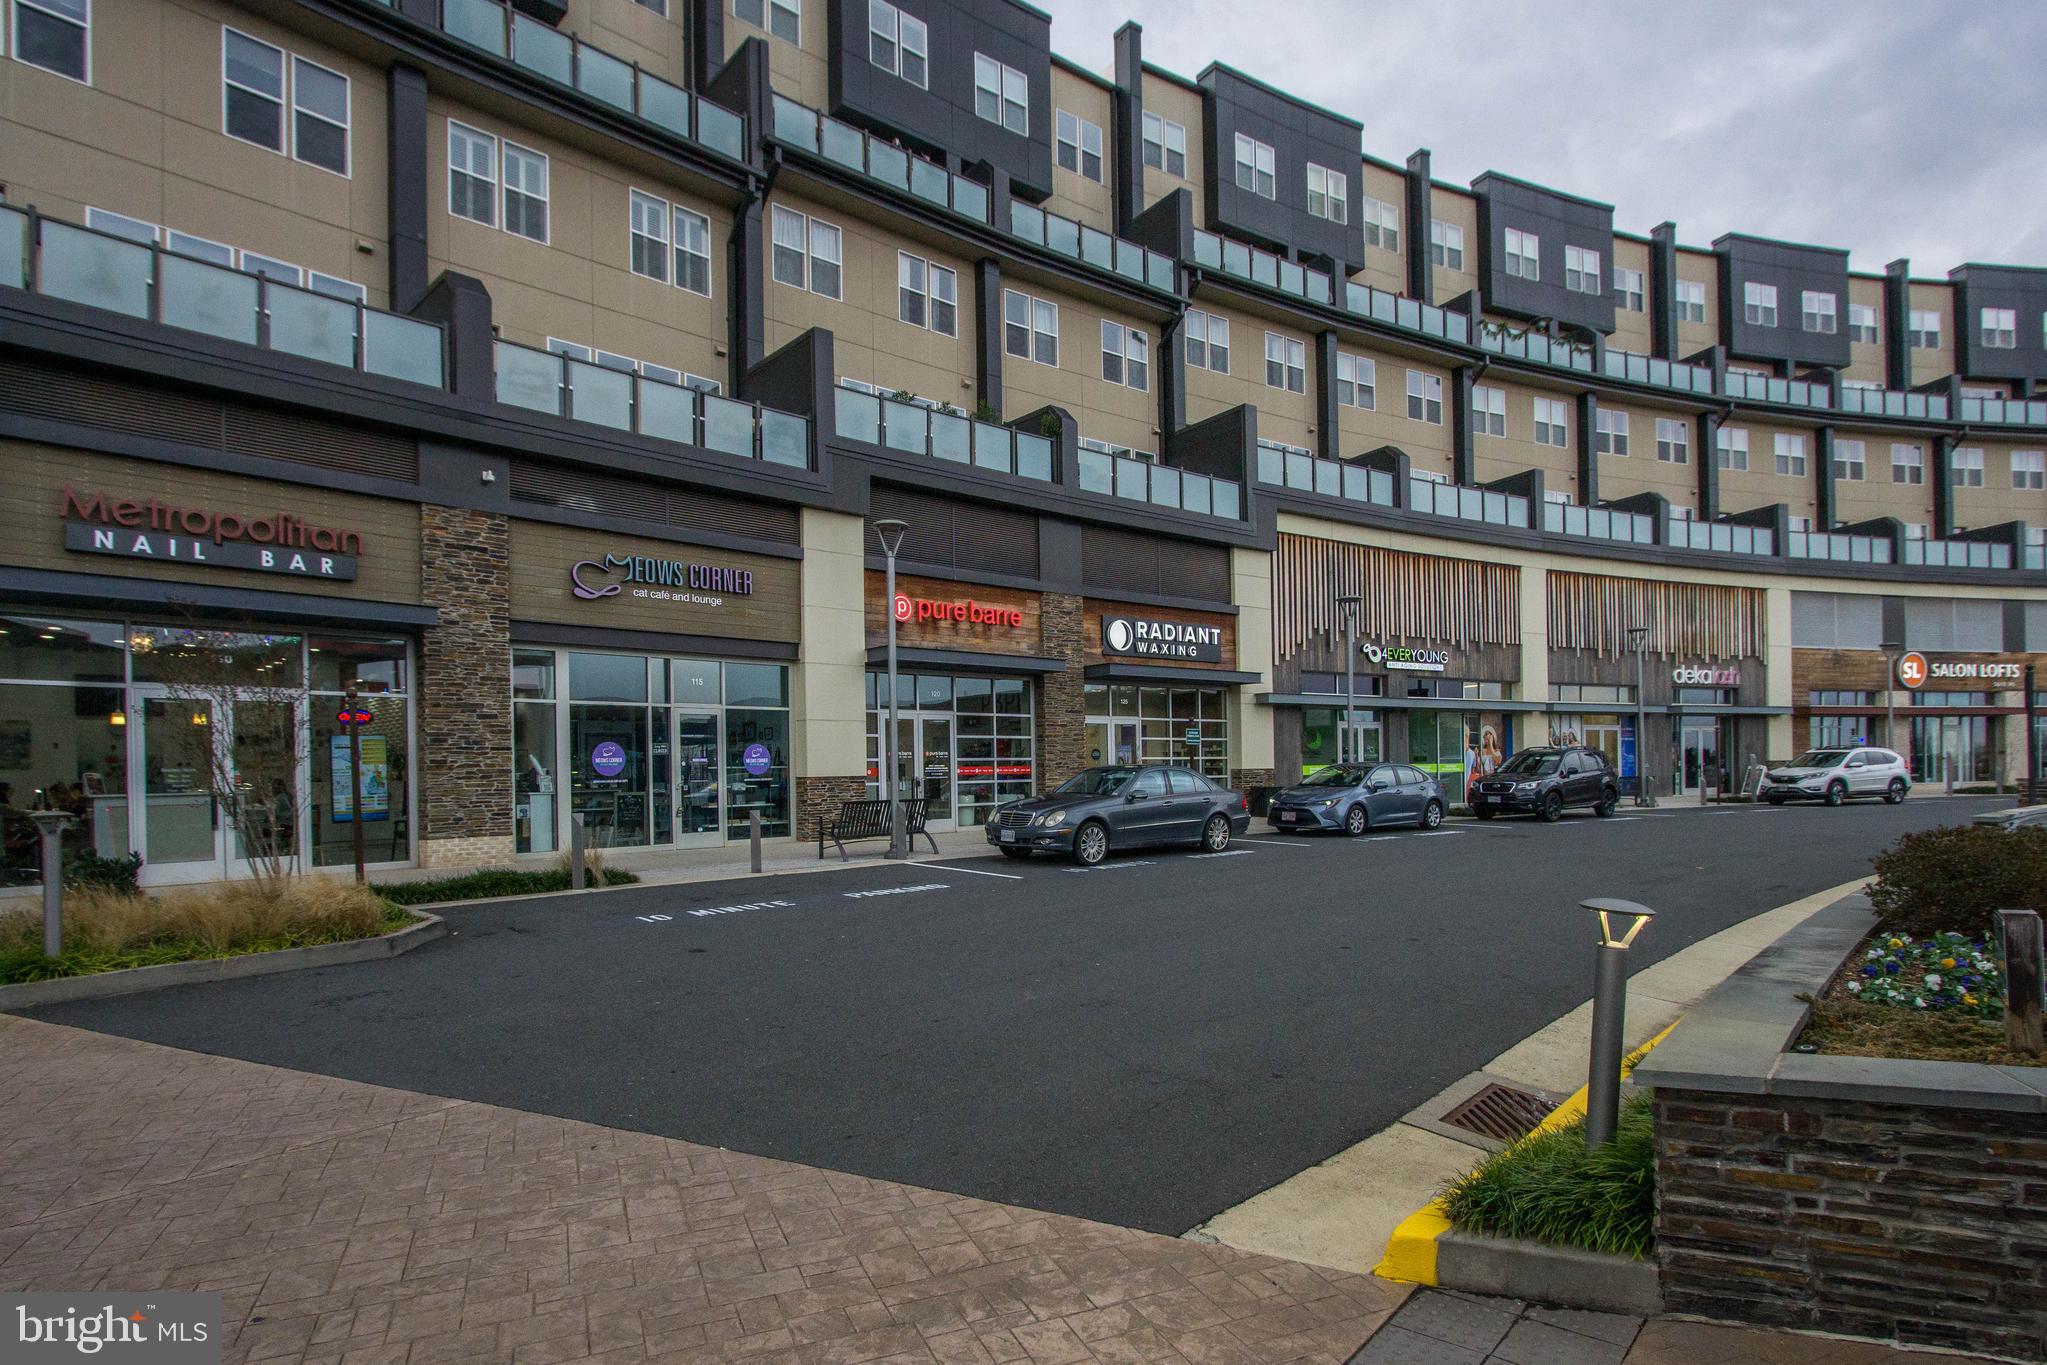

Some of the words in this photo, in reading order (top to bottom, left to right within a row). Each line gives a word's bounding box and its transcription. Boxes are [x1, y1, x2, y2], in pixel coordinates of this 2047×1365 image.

[59, 484, 363, 555] Metropolitan
[94, 529, 207, 561] NAIL
[260, 549, 335, 575] BAR
[605, 552, 684, 587] MEOWS
[689, 563, 753, 595] CORNER
[633, 588, 648, 598] cat
[650, 590, 670, 600] café
[672, 592, 690, 602] and
[691, 593, 723, 607] lounge
[917, 599, 967, 623] pure
[968, 600, 1023, 628] barre
[1136, 621, 1221, 645] RADIANT
[1137, 642, 1198, 657] WAXING
[691, 678, 704, 686] 115
[1902, 662, 1922, 679] SL
[1930, 663, 1978, 678] SALON
[1979, 663, 2020, 679] LOFTS
[635, 914, 673, 923] 10
[686, 899, 797, 917] MINUTE
[842, 883, 952, 899] PARKING
